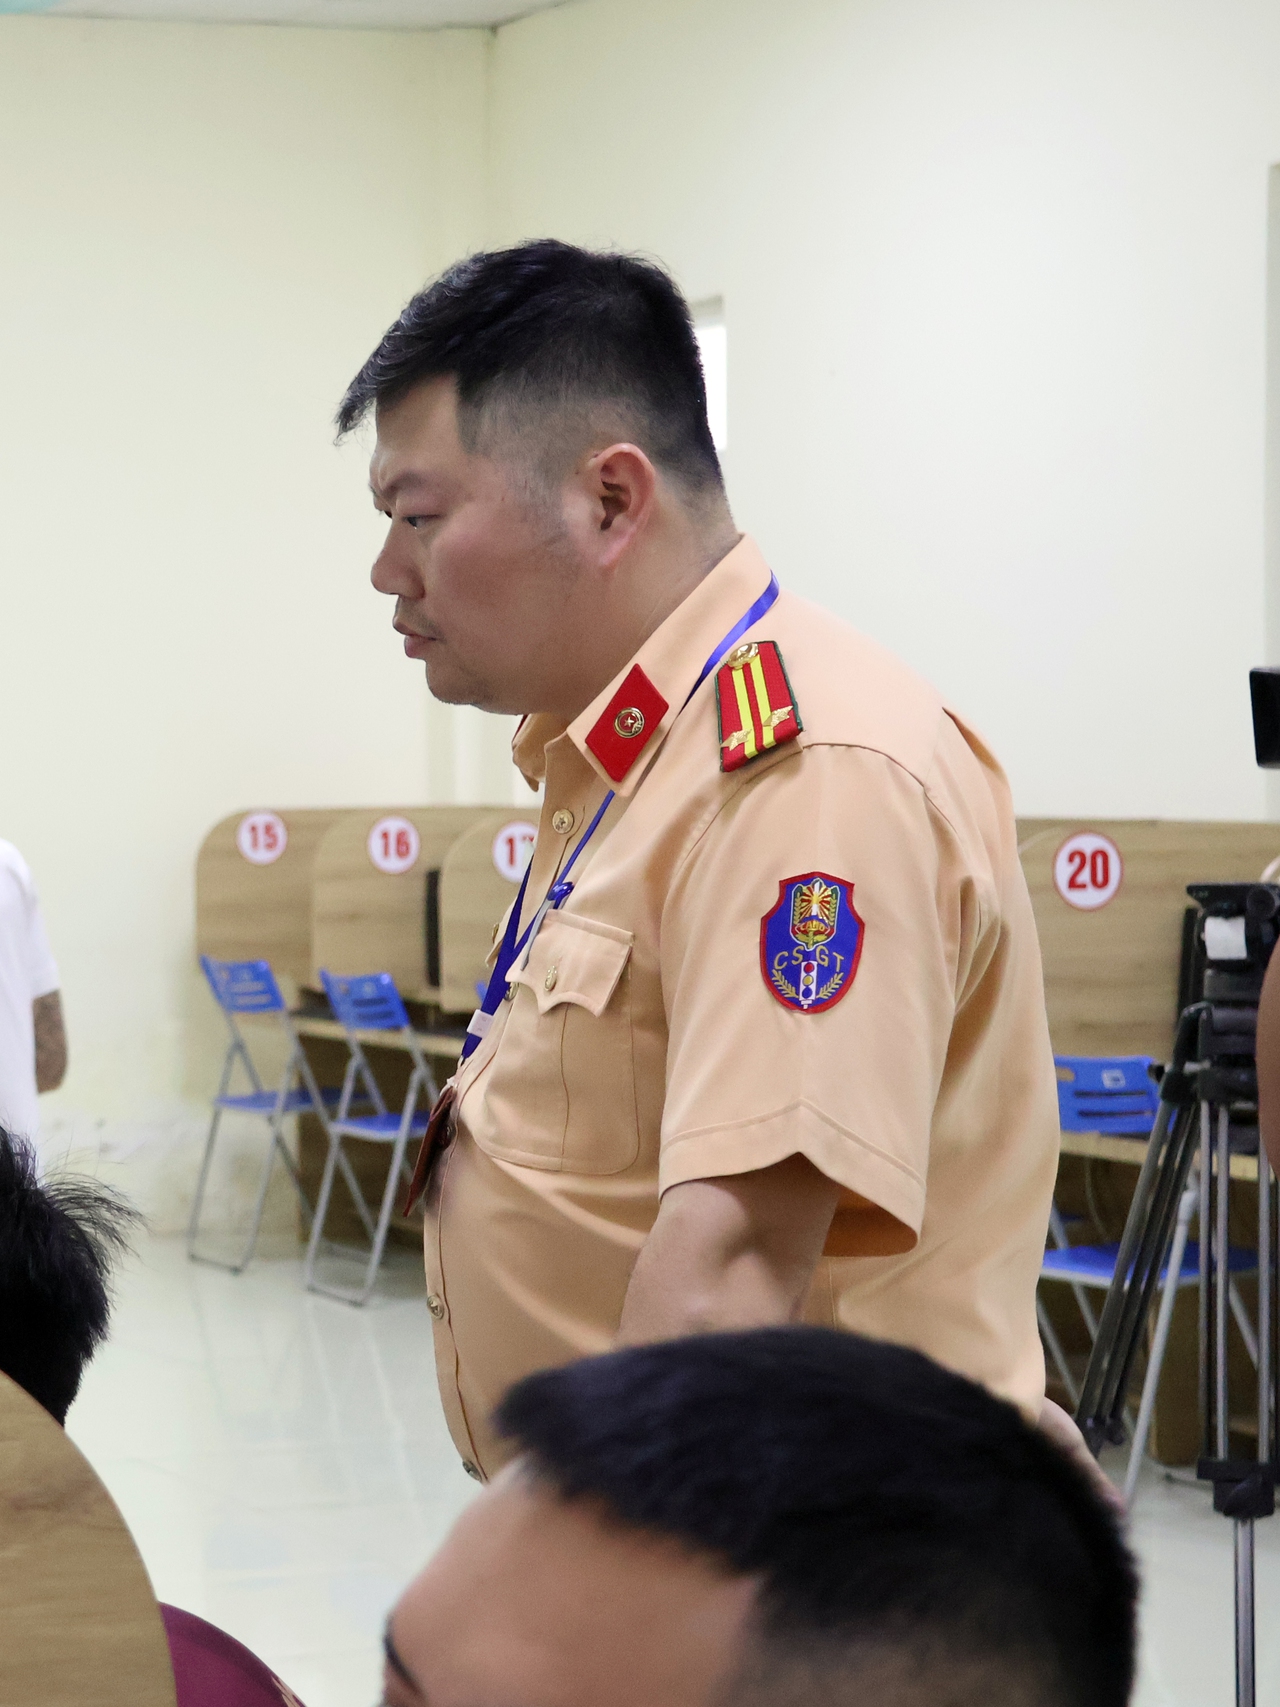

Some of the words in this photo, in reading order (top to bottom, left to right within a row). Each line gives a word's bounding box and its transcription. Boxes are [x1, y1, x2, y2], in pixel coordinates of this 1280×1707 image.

[250, 824, 279, 851] 15
[381, 831, 411, 859] 16
[506, 835, 534, 867] 1
[1067, 849, 1110, 889] 20
[774, 945, 844, 972] CSGT
